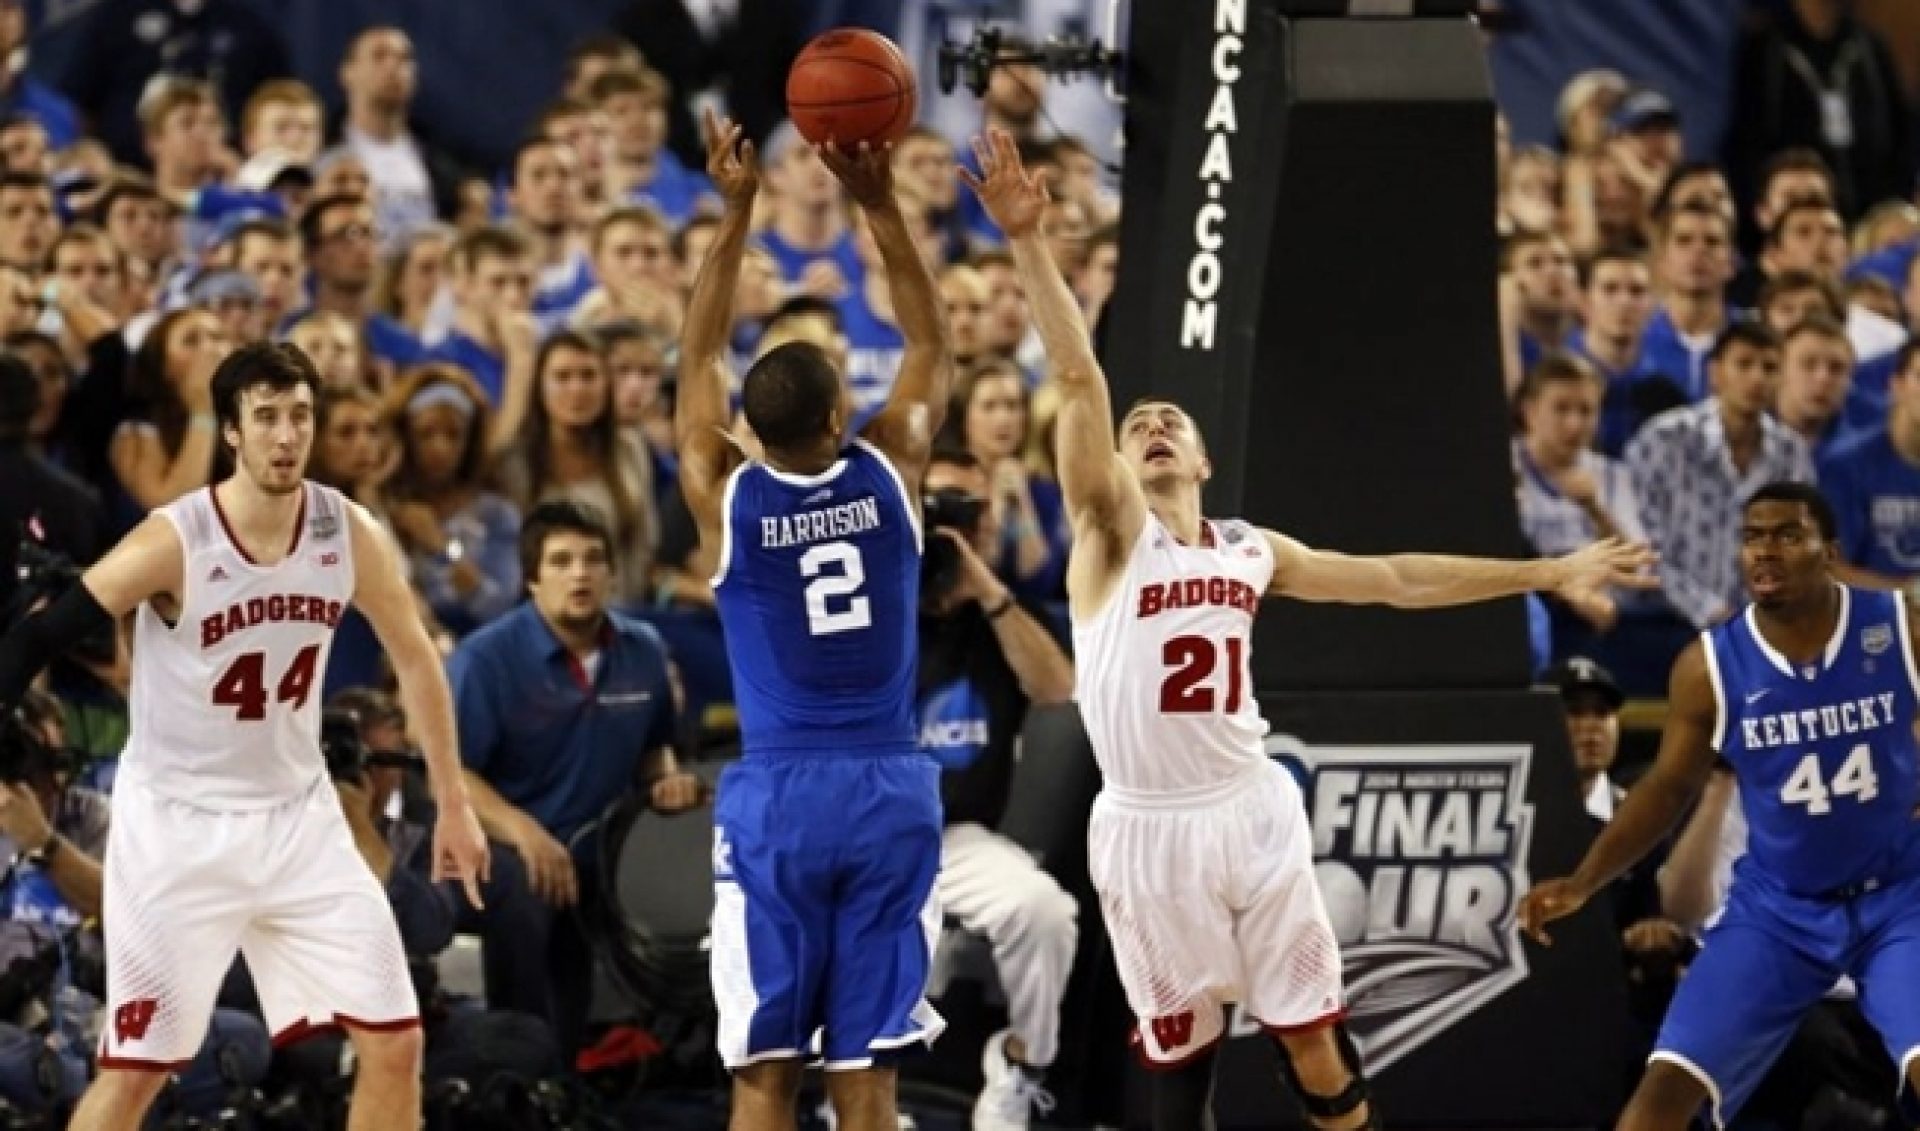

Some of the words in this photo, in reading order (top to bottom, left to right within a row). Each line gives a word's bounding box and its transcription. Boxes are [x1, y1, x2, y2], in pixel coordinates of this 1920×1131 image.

[761, 496, 880, 548] HARRISON
[201, 594, 342, 648] BADGERS
[798, 541, 872, 636] 2
[1137, 576, 1259, 620] BADGER
[212, 644, 321, 721] 44
[1160, 635, 1242, 715] 21
[1742, 691, 1895, 749] KENTUCKY
[1312, 770, 1509, 857] FINAL
[1780, 744, 1879, 815] 44
[1314, 860, 1511, 950] OUR
